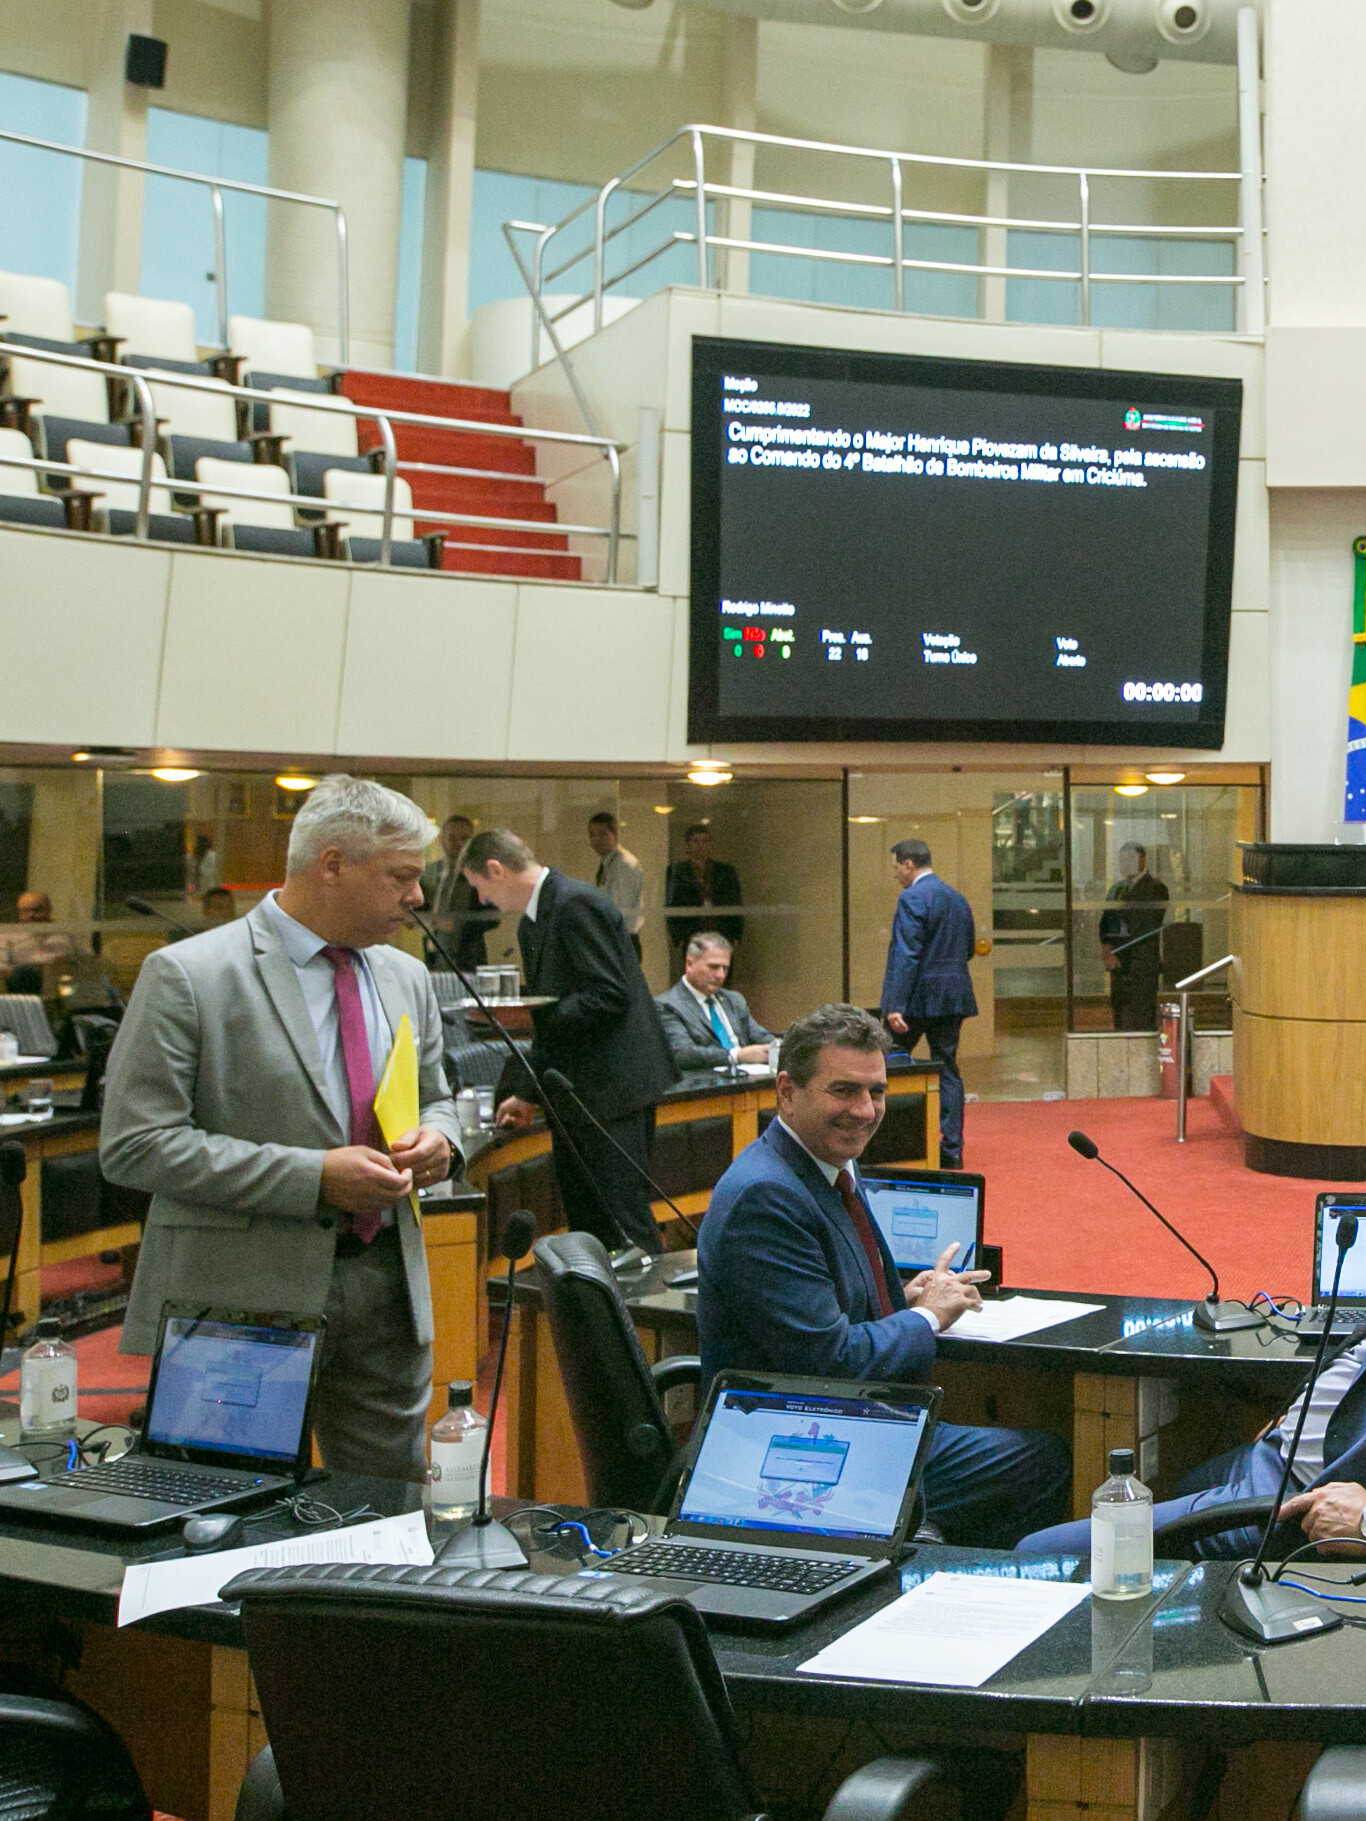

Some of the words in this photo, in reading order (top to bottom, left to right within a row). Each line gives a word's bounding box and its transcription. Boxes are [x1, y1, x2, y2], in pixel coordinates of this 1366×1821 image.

[727, 421, 851, 446] Cumprimentando
[853, 433, 864, 449] o
[865, 430, 906, 454] Major
[907, 433, 970, 457] Henrique
[1060, 443, 1112, 466] Silveira,
[1114, 448, 1143, 467] pela
[1144, 451, 1206, 470] ascensão
[727, 447, 749, 464] ao
[750, 445, 821, 468] Comando
[822, 451, 842, 469] do
[862, 452, 924, 475] Batalhão
[925, 457, 945, 475] de
[946, 457, 1019, 480] Bombeiros
[1020, 462, 1062, 483] Militar
[1062, 468, 1085, 484] em
[1086, 466, 1148, 488] Criciúma.
[734, 643, 743, 657] 0
[754, 644, 765, 658] 0
[781, 645, 791, 659] 0
[826, 646, 843, 661] 22
[1055, 636, 1079, 650] Voto
[1122, 682, 1203, 702] 00:00:00
